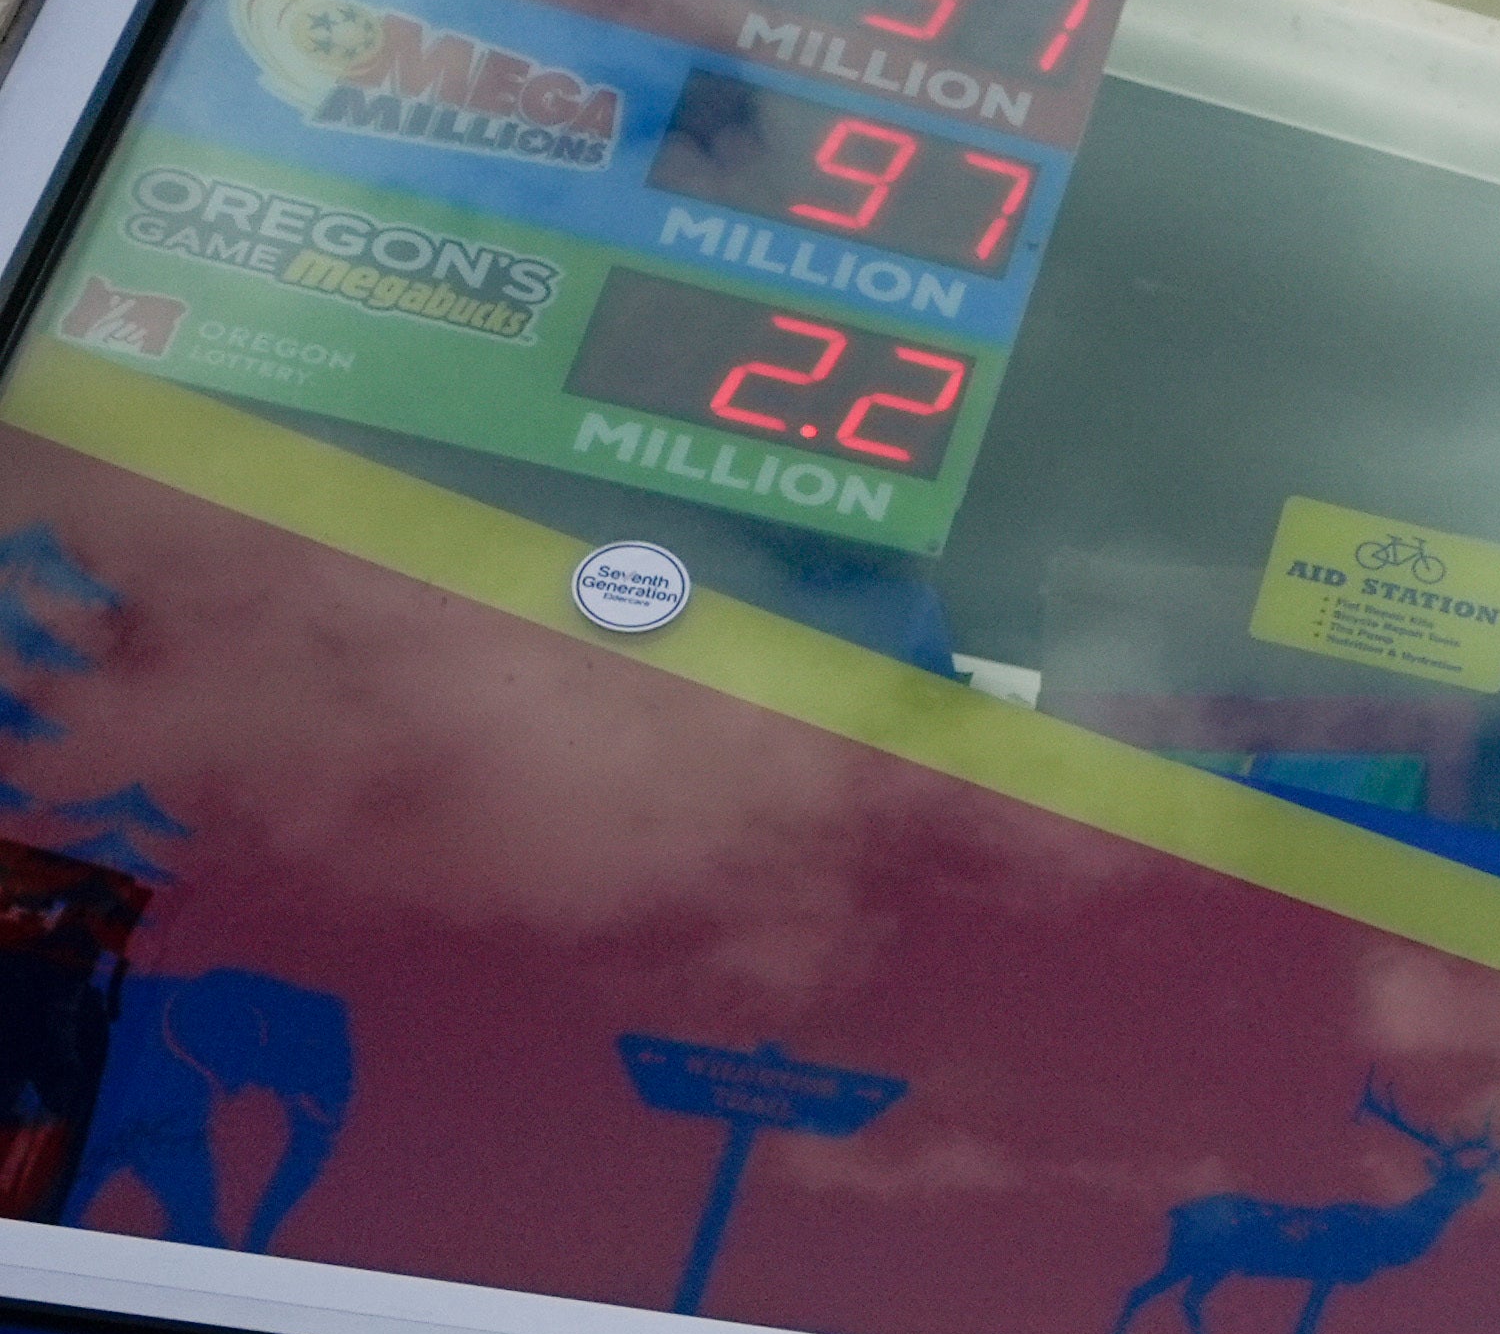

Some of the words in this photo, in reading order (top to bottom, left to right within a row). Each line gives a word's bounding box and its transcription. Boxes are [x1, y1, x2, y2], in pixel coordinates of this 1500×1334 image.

[337, 13, 619, 139] MEGA
[738, 11, 1034, 129] MILLION
[314, 84, 610, 165] MILLIONS
[136, 169, 559, 306] OREGON'S
[788, 119, 1035, 262] 97
[127, 215, 278, 272] GAME
[658, 206, 967, 321] MILLION
[188, 344, 314, 385] LOTTERY
[198, 320, 357, 372] OREGON
[709, 316, 967, 463] 2.2
[573, 412, 894, 524] MILLION
[582, 576, 678, 603] Generation
[597, 565, 670, 589] Seventh
[1286, 560, 1348, 587] AID
[1361, 578, 1500, 625] STATION
